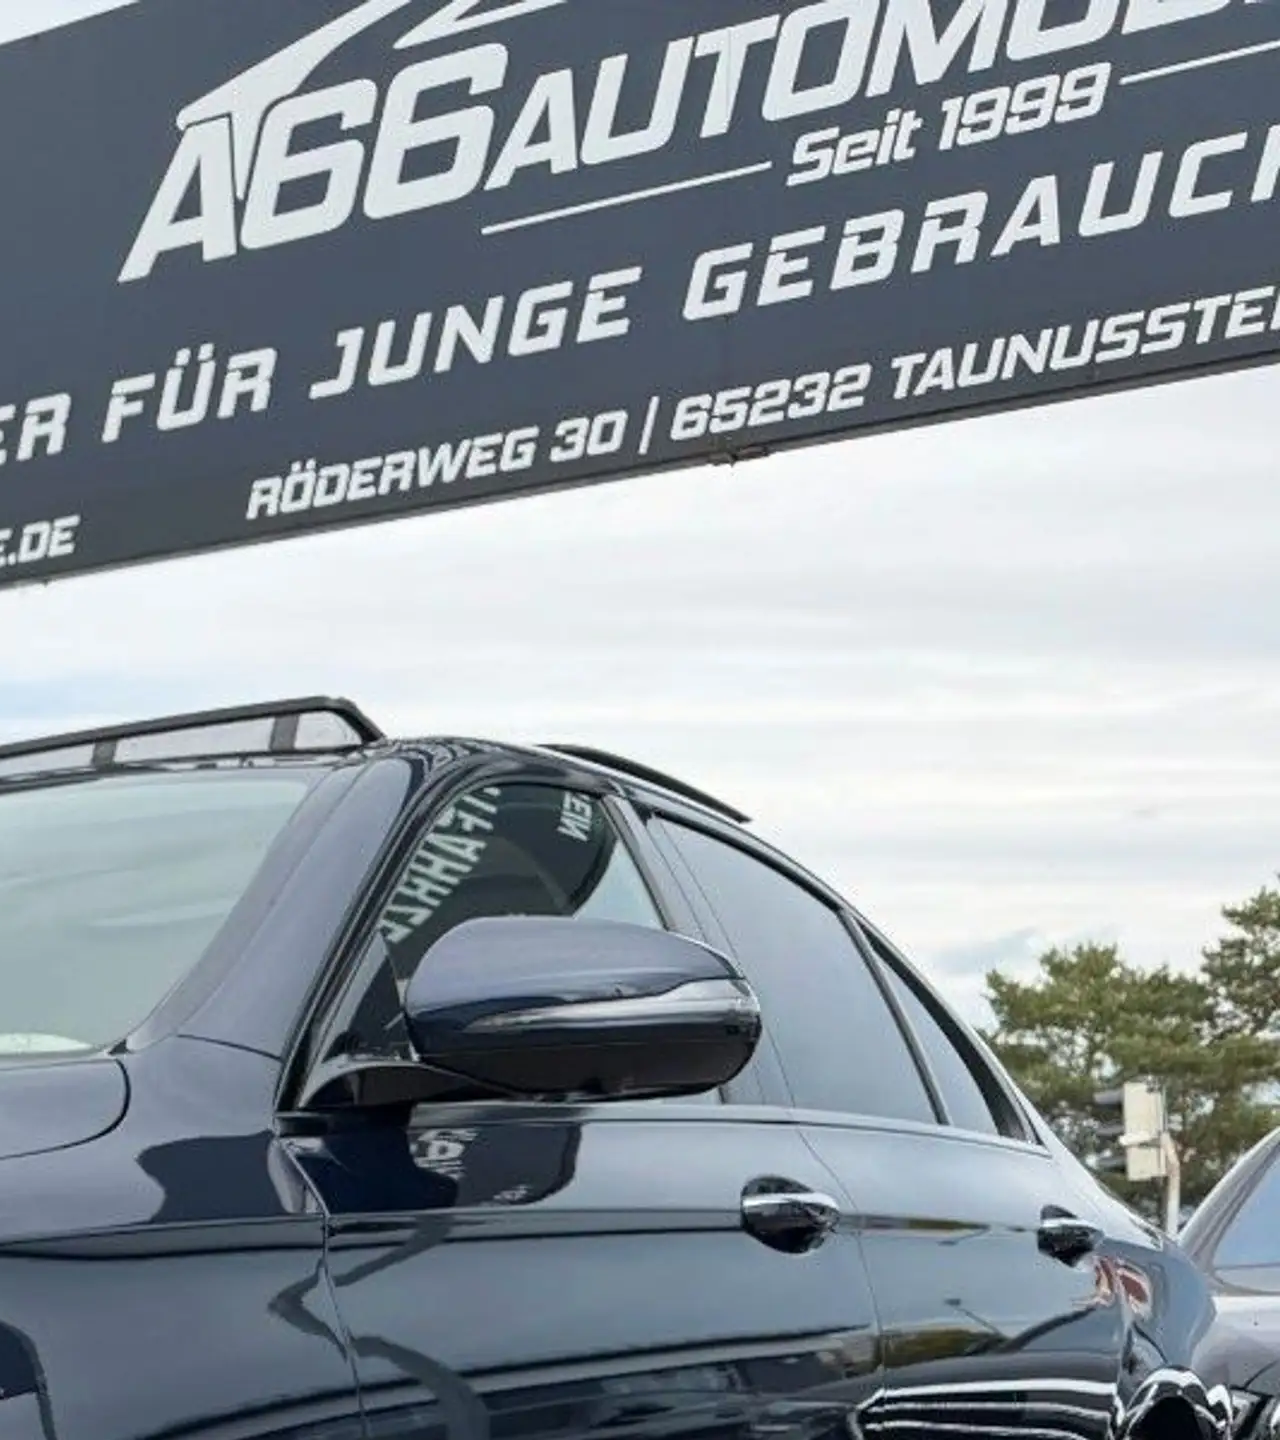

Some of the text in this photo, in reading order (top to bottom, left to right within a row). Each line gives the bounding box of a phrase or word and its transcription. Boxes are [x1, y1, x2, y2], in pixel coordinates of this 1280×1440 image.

[118, 0, 1248, 283] A66AUTOM
[786, 62, 1111, 187] Seit 1999
[101, 342, 278, 443] FÜR
[308, 266, 642, 400] JUNGE
[245, 425, 540, 519] RÖDERWEG
[549, 409, 628, 463] 30
[670, 363, 872, 442] 65232
